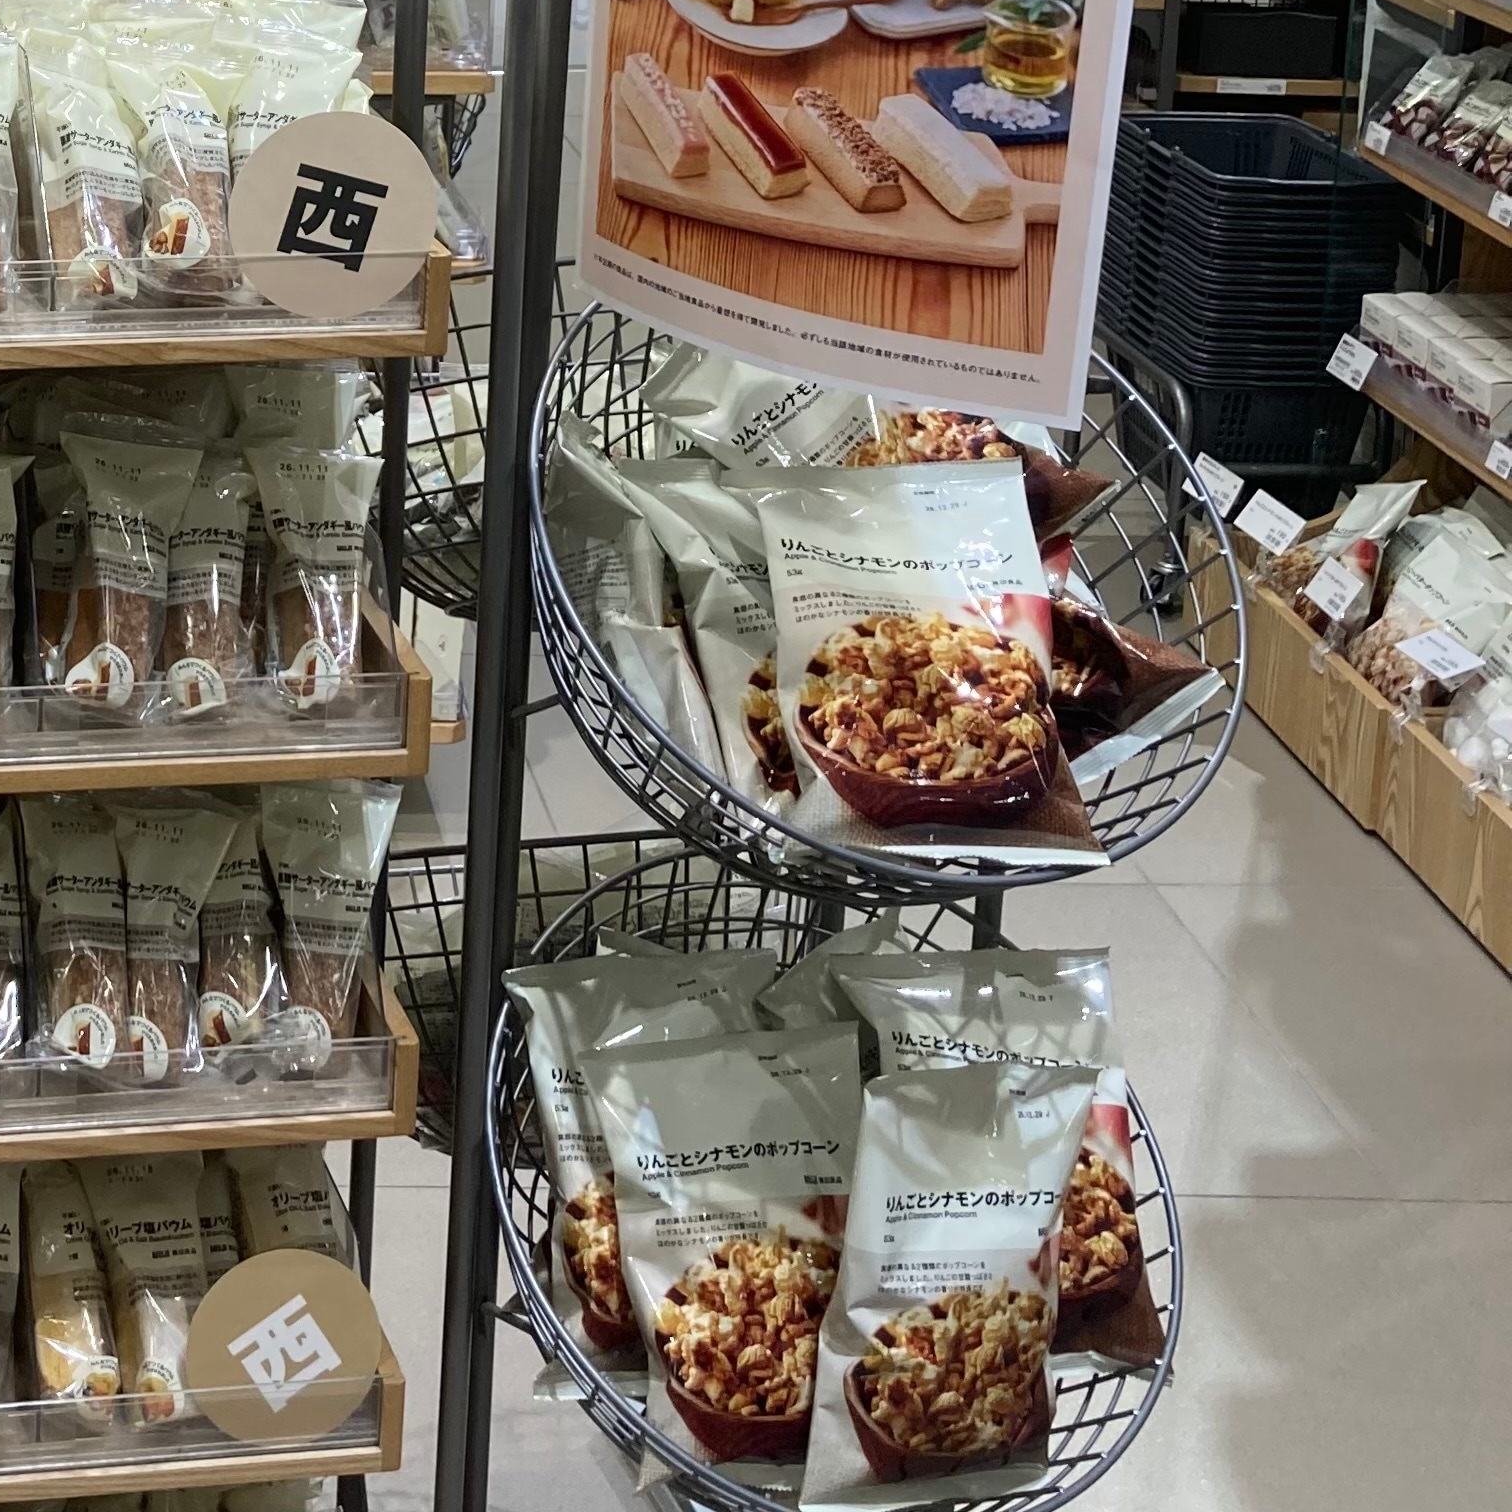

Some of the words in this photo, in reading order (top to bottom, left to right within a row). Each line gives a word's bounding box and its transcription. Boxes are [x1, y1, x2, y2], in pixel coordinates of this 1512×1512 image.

[277, 163, 388, 272] 西
[637, 1140, 840, 1171] りんごとシナモンのポップコーン
[642, 1170, 665, 1181] Apple
[226, 1293, 342, 1413] 西
